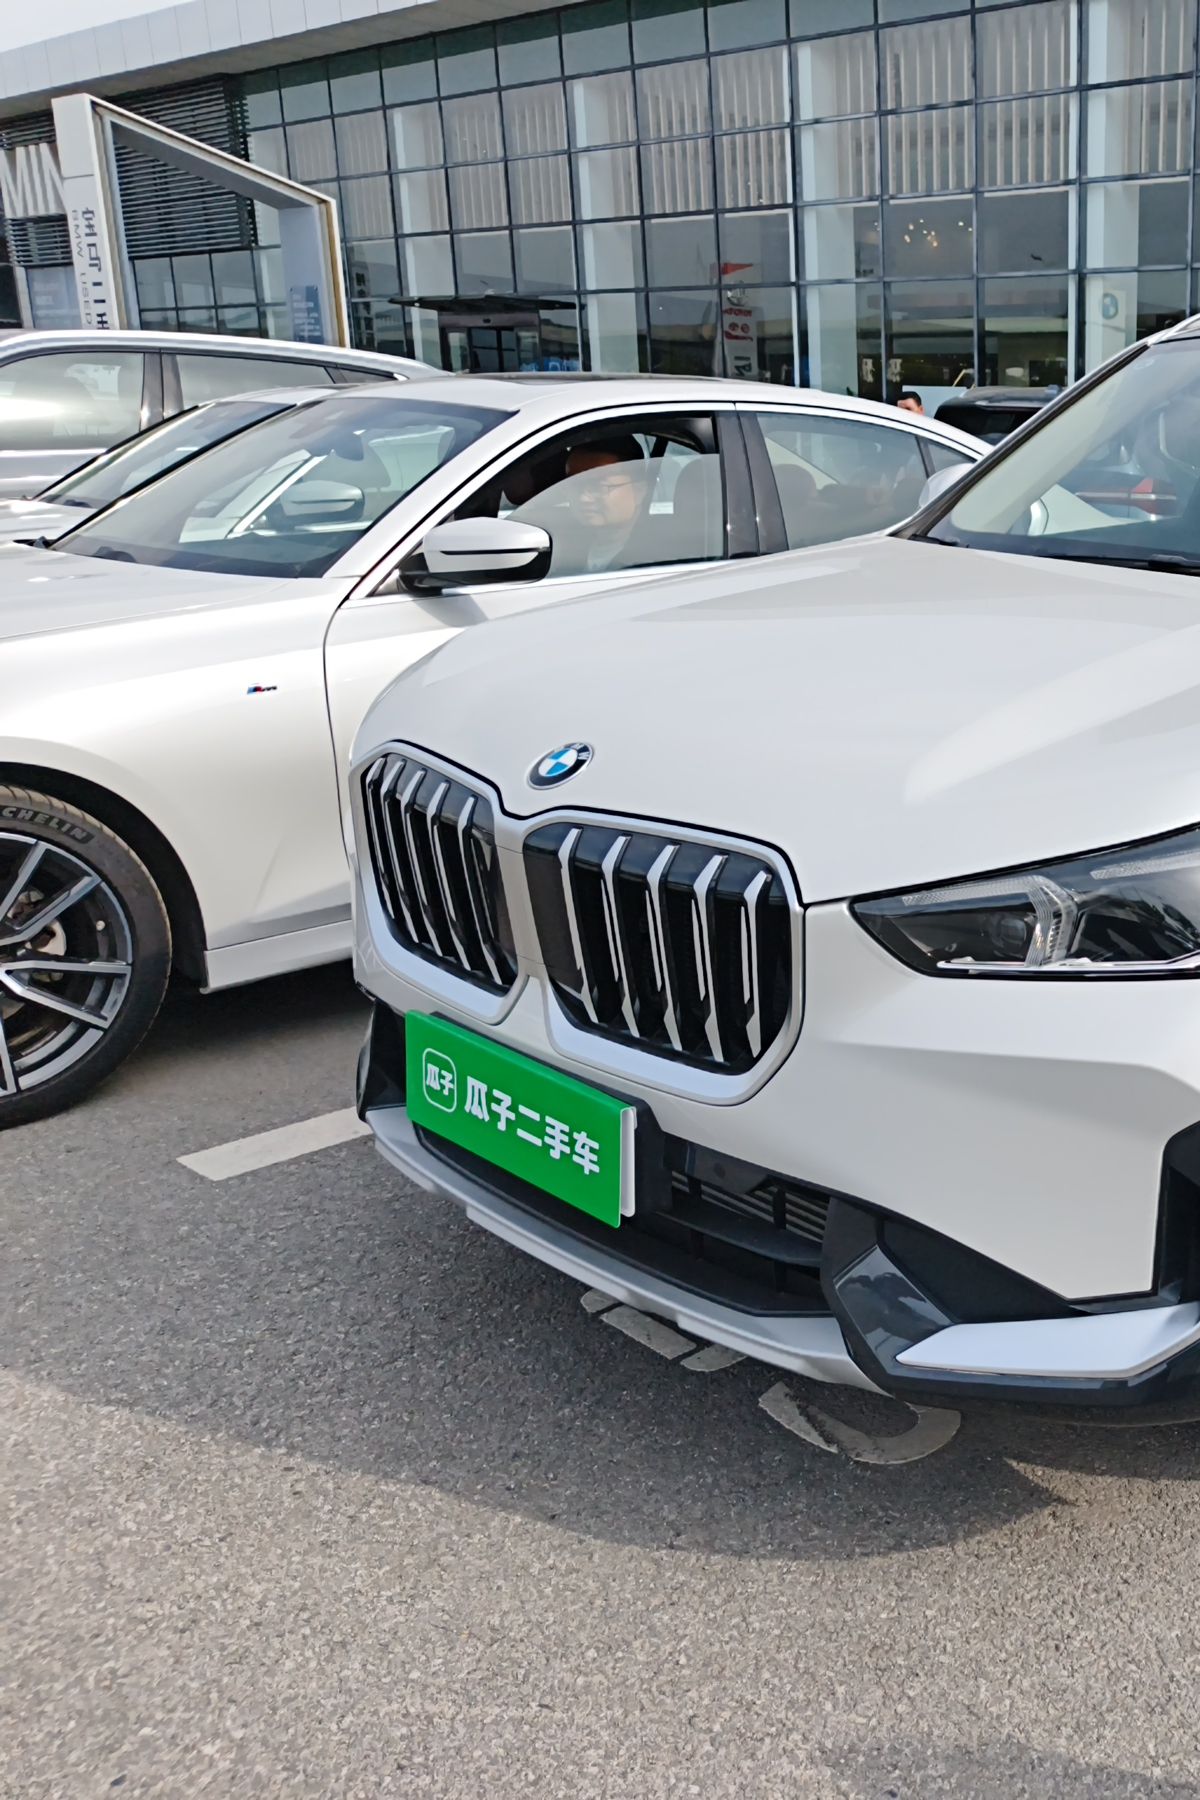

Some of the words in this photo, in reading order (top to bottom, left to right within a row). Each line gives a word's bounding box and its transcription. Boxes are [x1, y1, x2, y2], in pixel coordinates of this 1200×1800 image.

[72, 211, 84, 258] BMW
[80, 272, 92, 325] USED
[2, 807, 87, 839] CHELIN
[426, 1063, 454, 1096] 瓜子
[464, 1075, 600, 1175] 瓜子二手车
